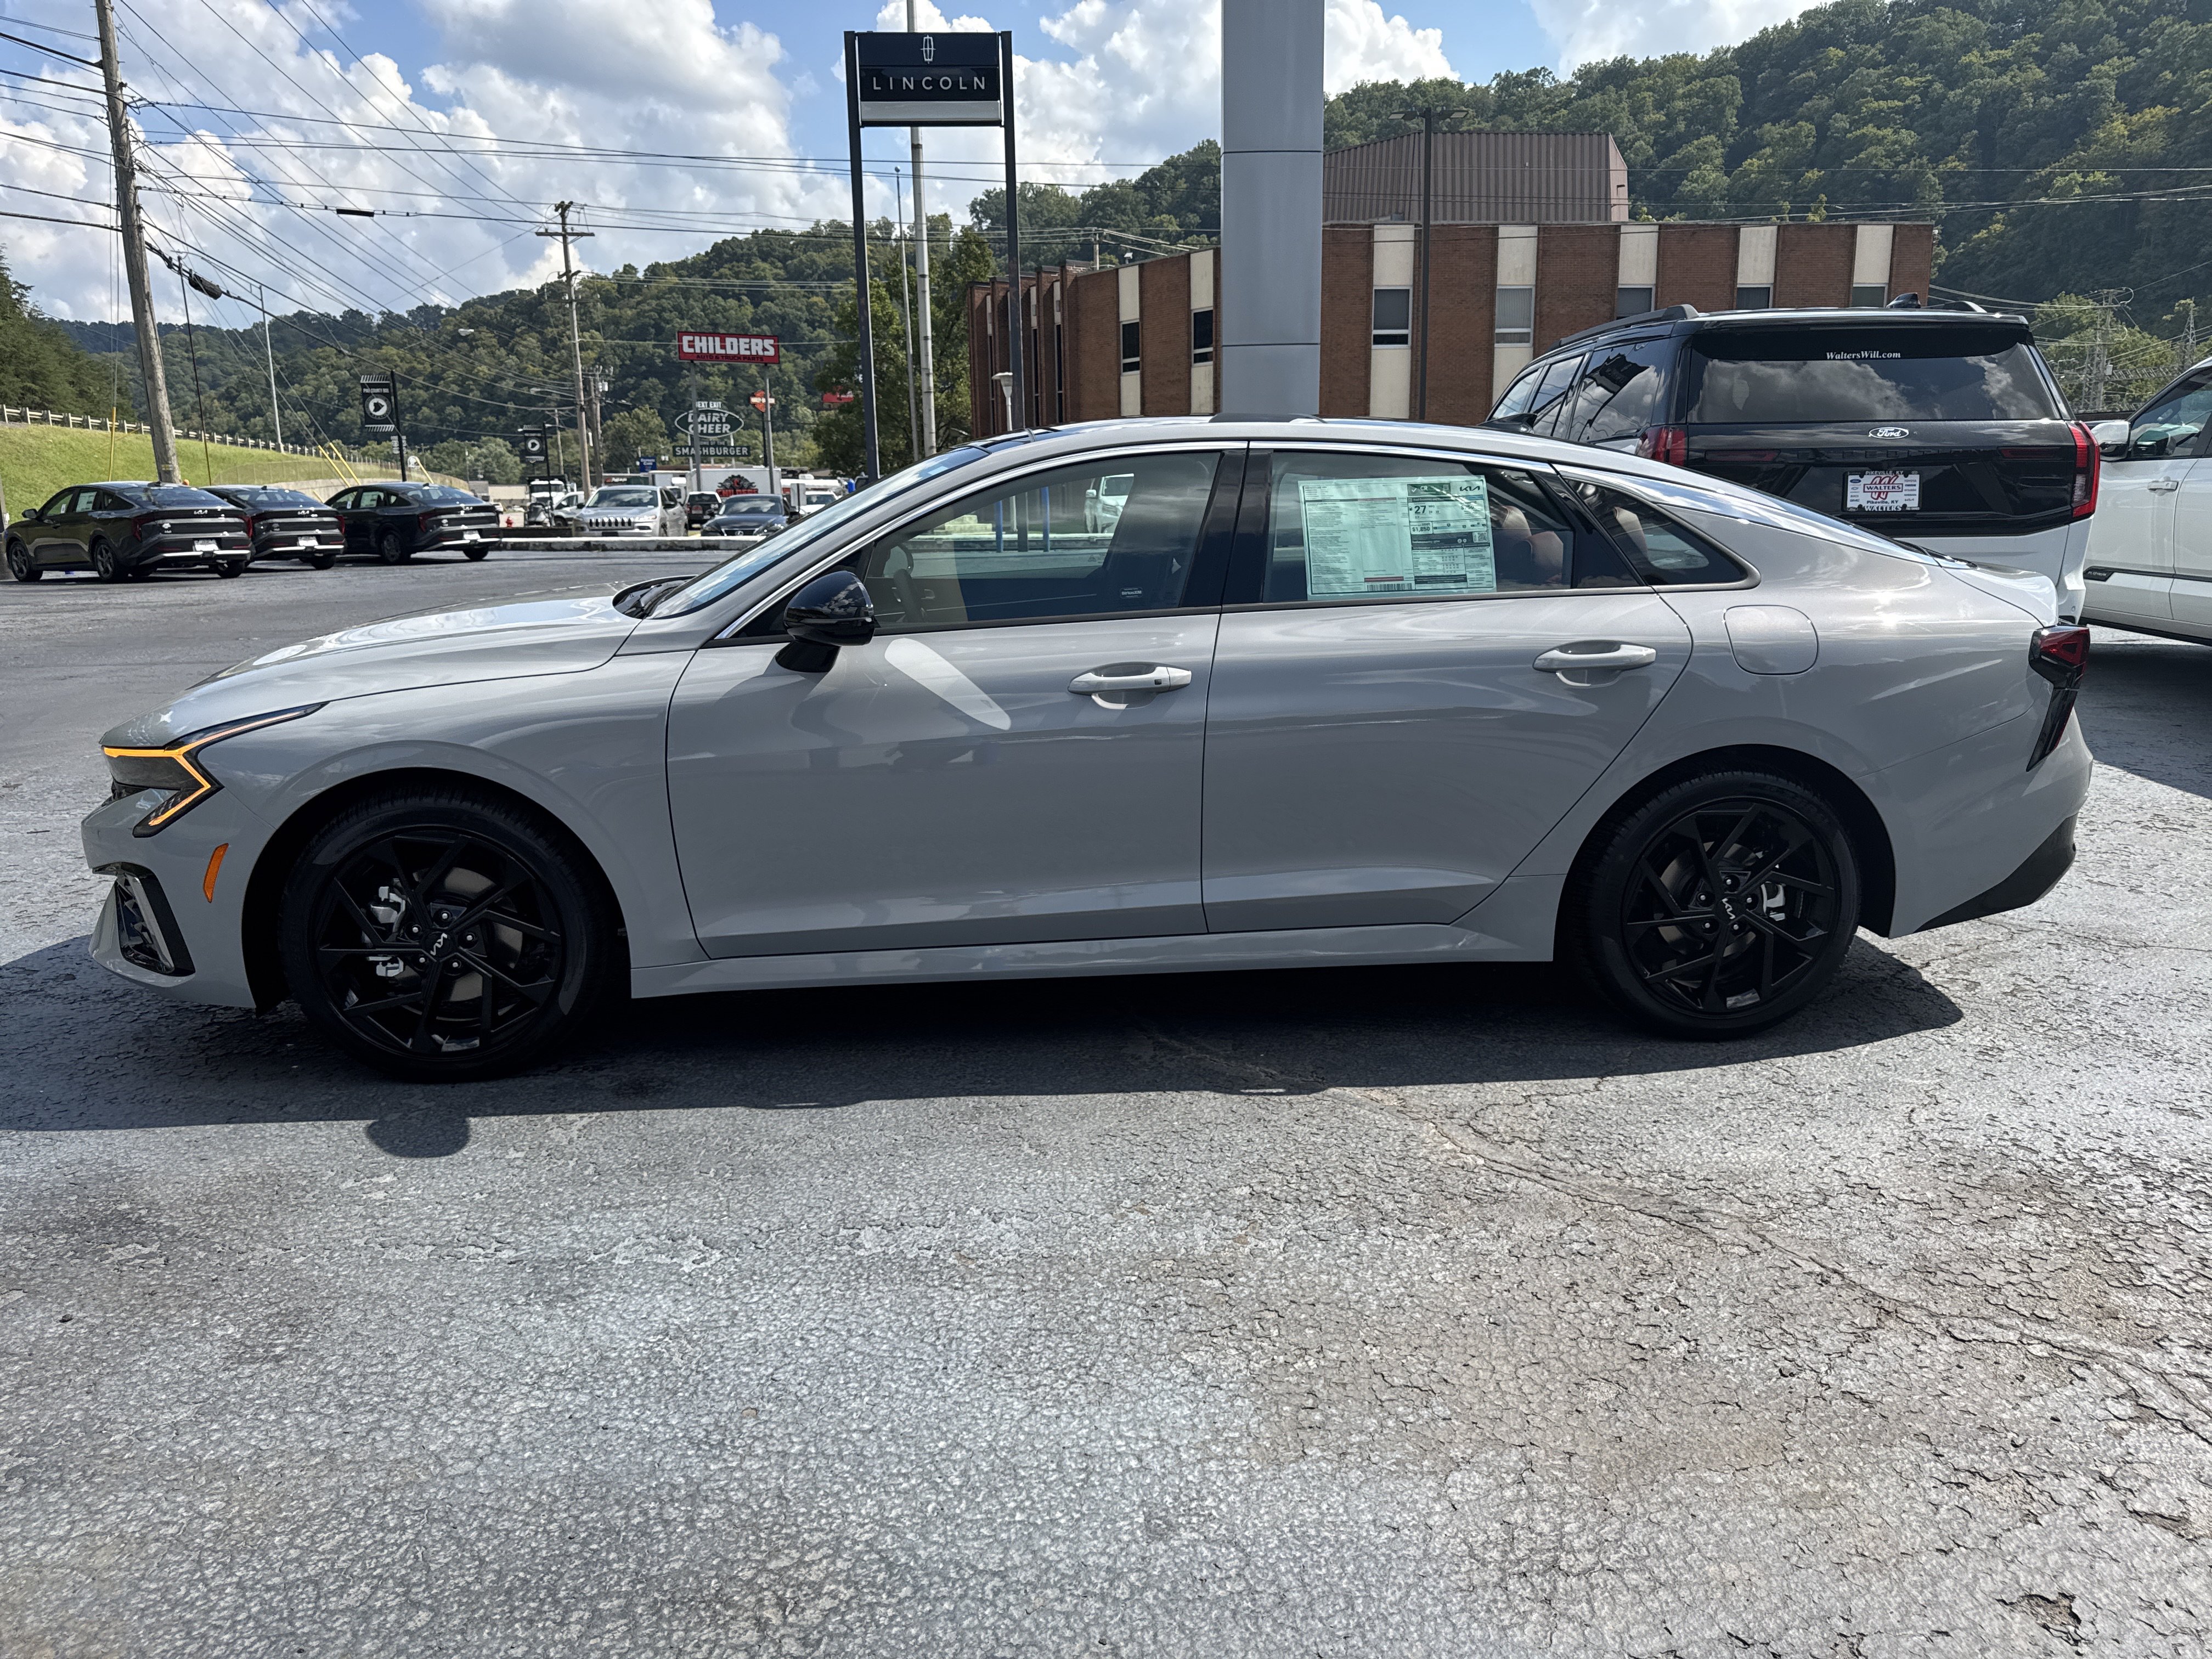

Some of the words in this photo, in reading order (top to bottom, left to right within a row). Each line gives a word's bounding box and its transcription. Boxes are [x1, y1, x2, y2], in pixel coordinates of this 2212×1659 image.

[873, 76, 985, 91] LINCOLN
[682, 335, 775, 356] CHILDERS
[1826, 351, 1901, 359] WaltersWill.com
[689, 424, 731, 433] CHEER
[1876, 428, 1901, 437] Ford
[1414, 505, 1426, 514] 27
